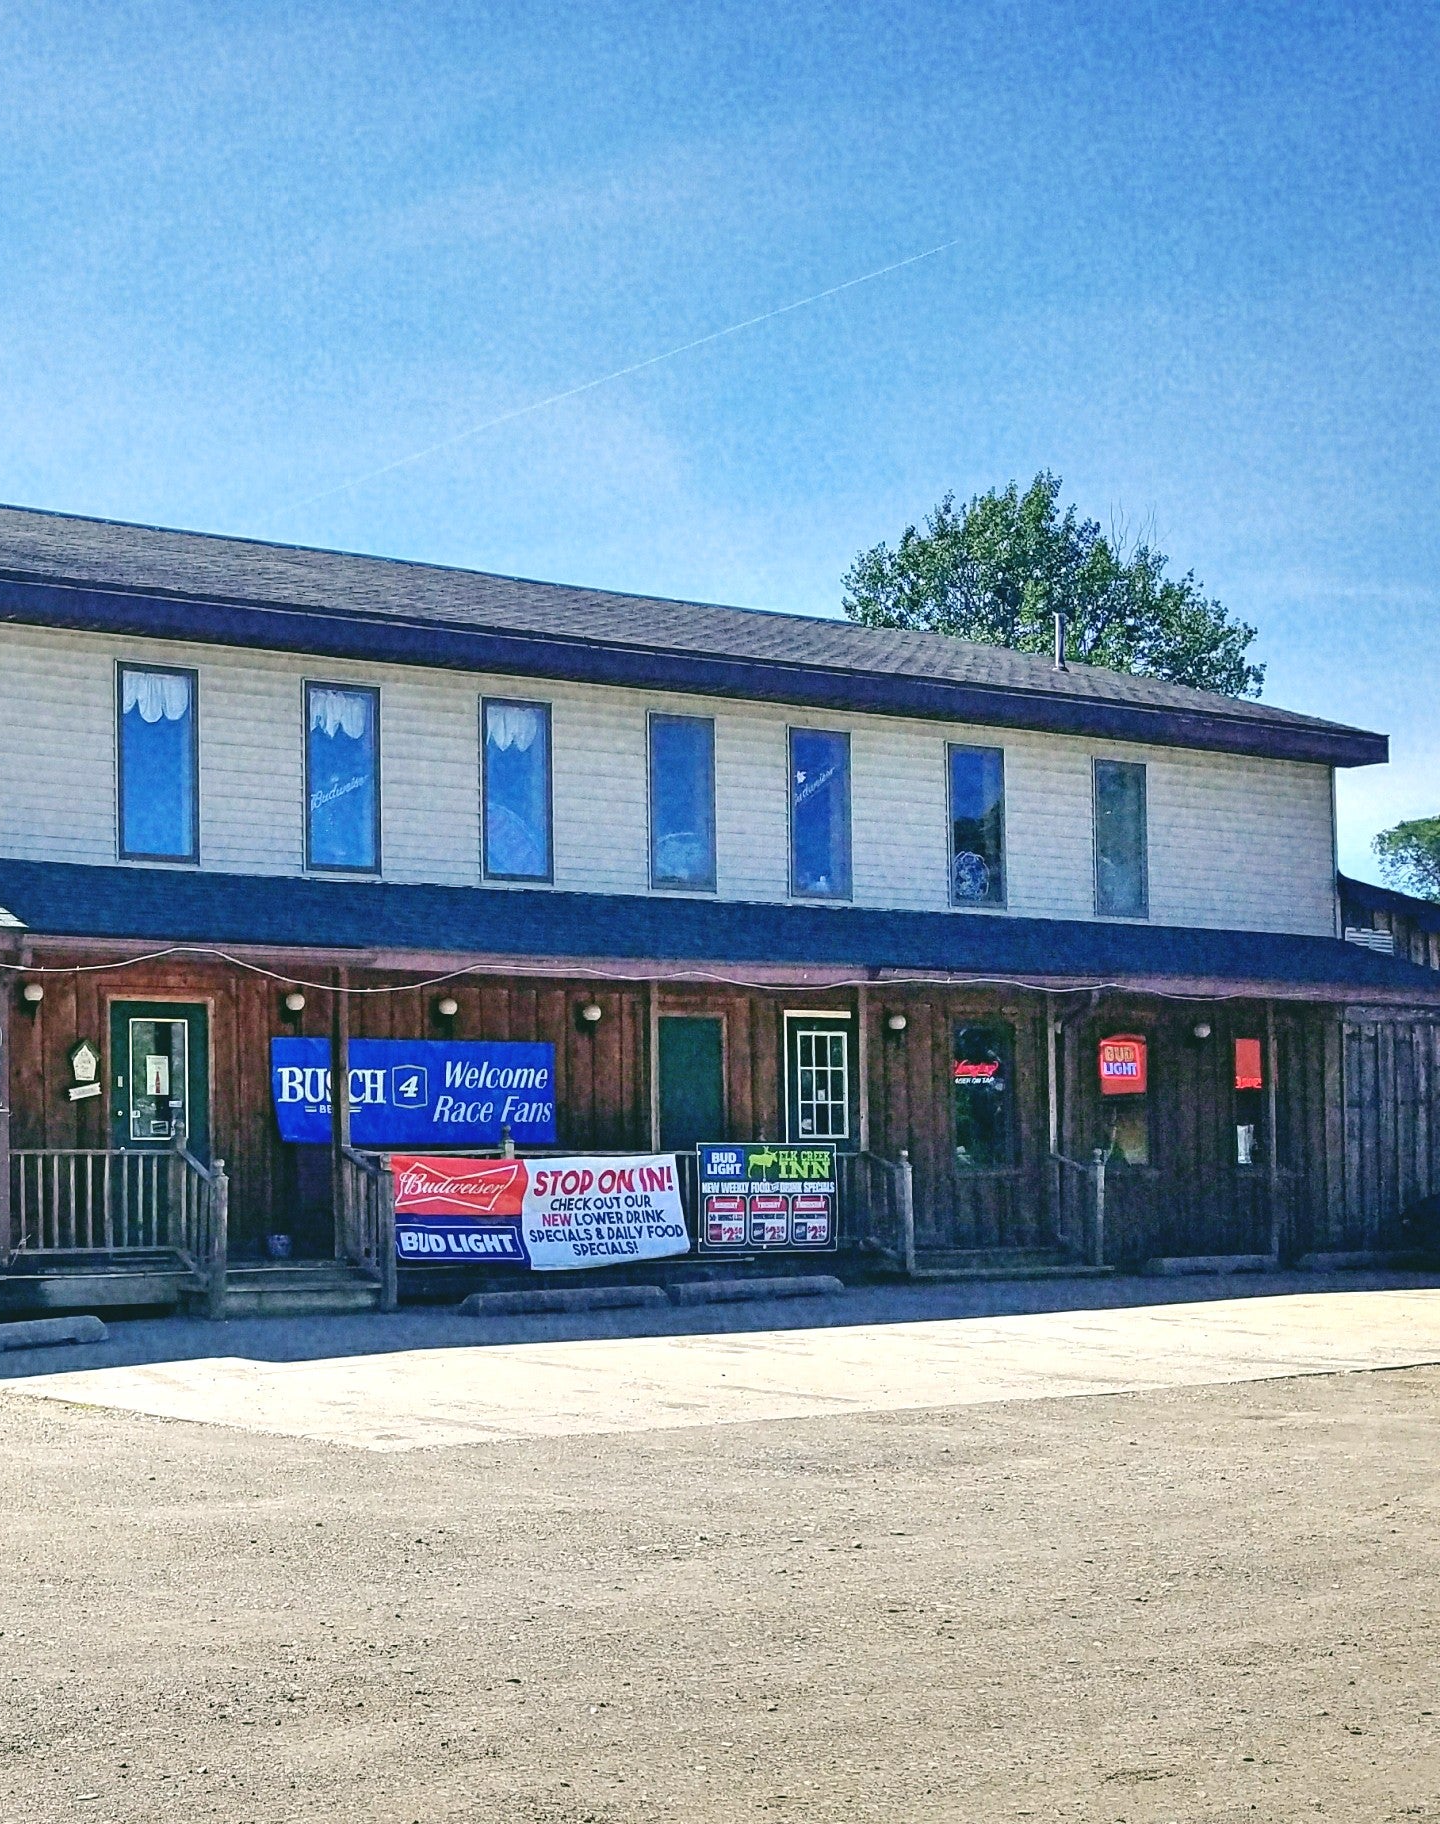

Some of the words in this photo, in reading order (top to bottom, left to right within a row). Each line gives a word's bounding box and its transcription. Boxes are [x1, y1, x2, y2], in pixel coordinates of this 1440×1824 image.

[1104, 1046, 1134, 1062] BUD
[444, 1060, 548, 1089] Welcome
[1103, 1062, 1137, 1075] LIGHT
[277, 1066, 388, 1105] BUCH
[398, 1075, 420, 1098] 4
[319, 1105, 333, 1114] BE
[432, 1095, 493, 1123] Race
[500, 1095, 553, 1123] Fans
[711, 1152, 737, 1163] BUD
[778, 1150, 799, 1161] ELK
[800, 1150, 831, 1162] CREEK
[707, 1163, 742, 1175] LIGHT
[778, 1161, 831, 1178] INN
[399, 1172, 508, 1195] Budweiser
[533, 1169, 594, 1197] STOP
[598, 1168, 635, 1194] ON
[638, 1166, 673, 1192] IN!
[702, 1182, 719, 1193] NEW
[550, 1196, 594, 1212] CHECK
[595, 1196, 621, 1210] OUT
[624, 1194, 652, 1209] OUR
[542, 1213, 572, 1227] NEW
[575, 1211, 623, 1226] LOWER
[626, 1209, 666, 1224] DRINK
[529, 1228, 593, 1243] SPECIALS
[595, 1228, 604, 1241] &
[607, 1226, 643, 1241] DAILY
[647, 1224, 684, 1238] FOOD
[402, 1232, 447, 1253] BUD
[449, 1233, 514, 1254] LIGHT
[573, 1241, 640, 1257] SPECIALS!
